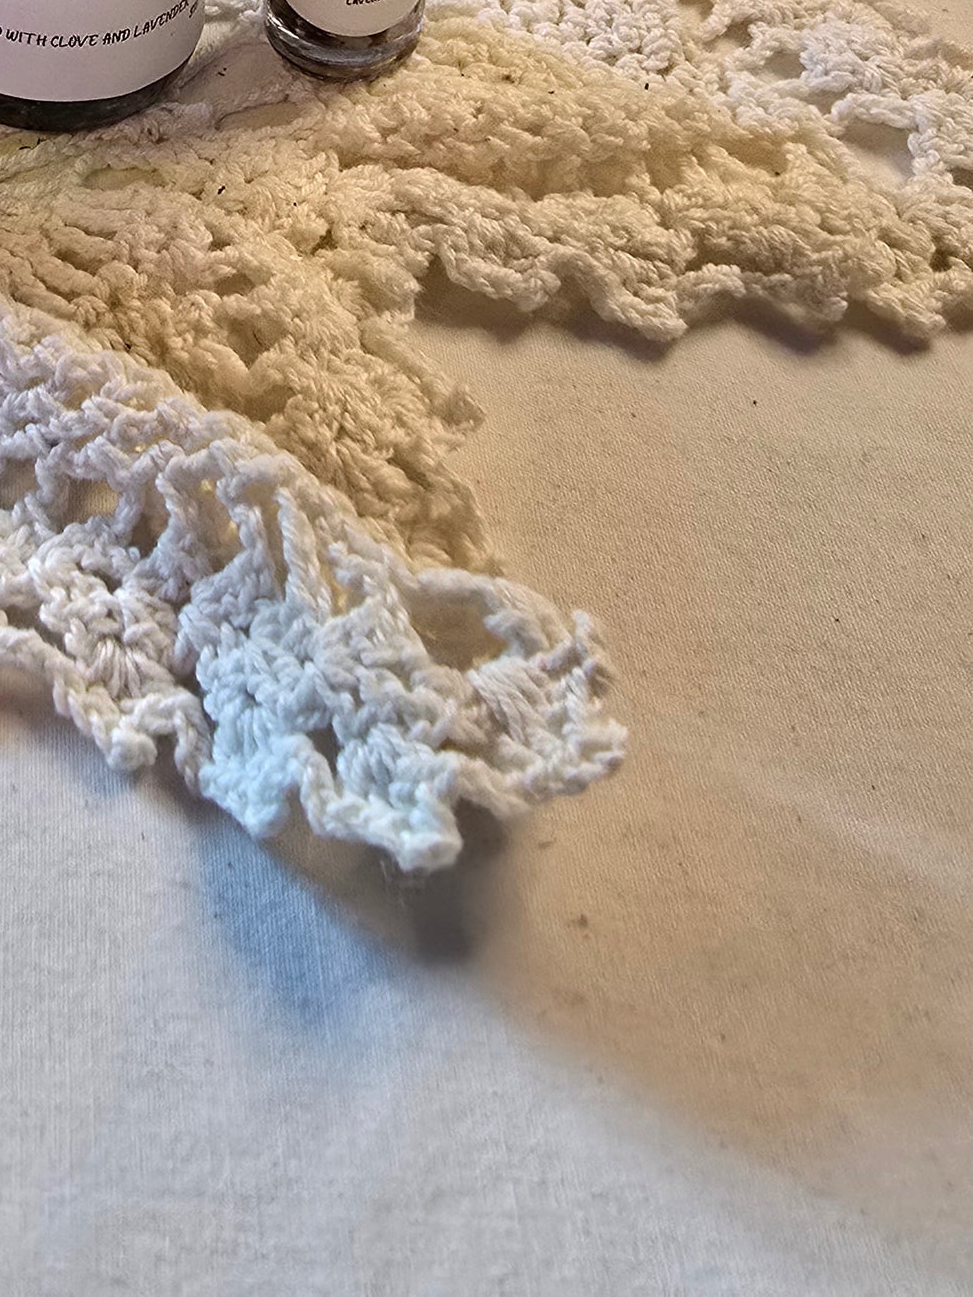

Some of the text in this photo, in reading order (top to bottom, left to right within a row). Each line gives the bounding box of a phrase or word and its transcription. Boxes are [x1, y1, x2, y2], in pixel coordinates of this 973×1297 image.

[6, 29, 47, 47] WITH
[50, 34, 99, 48] CLOVE
[102, 27, 130, 45] AND
